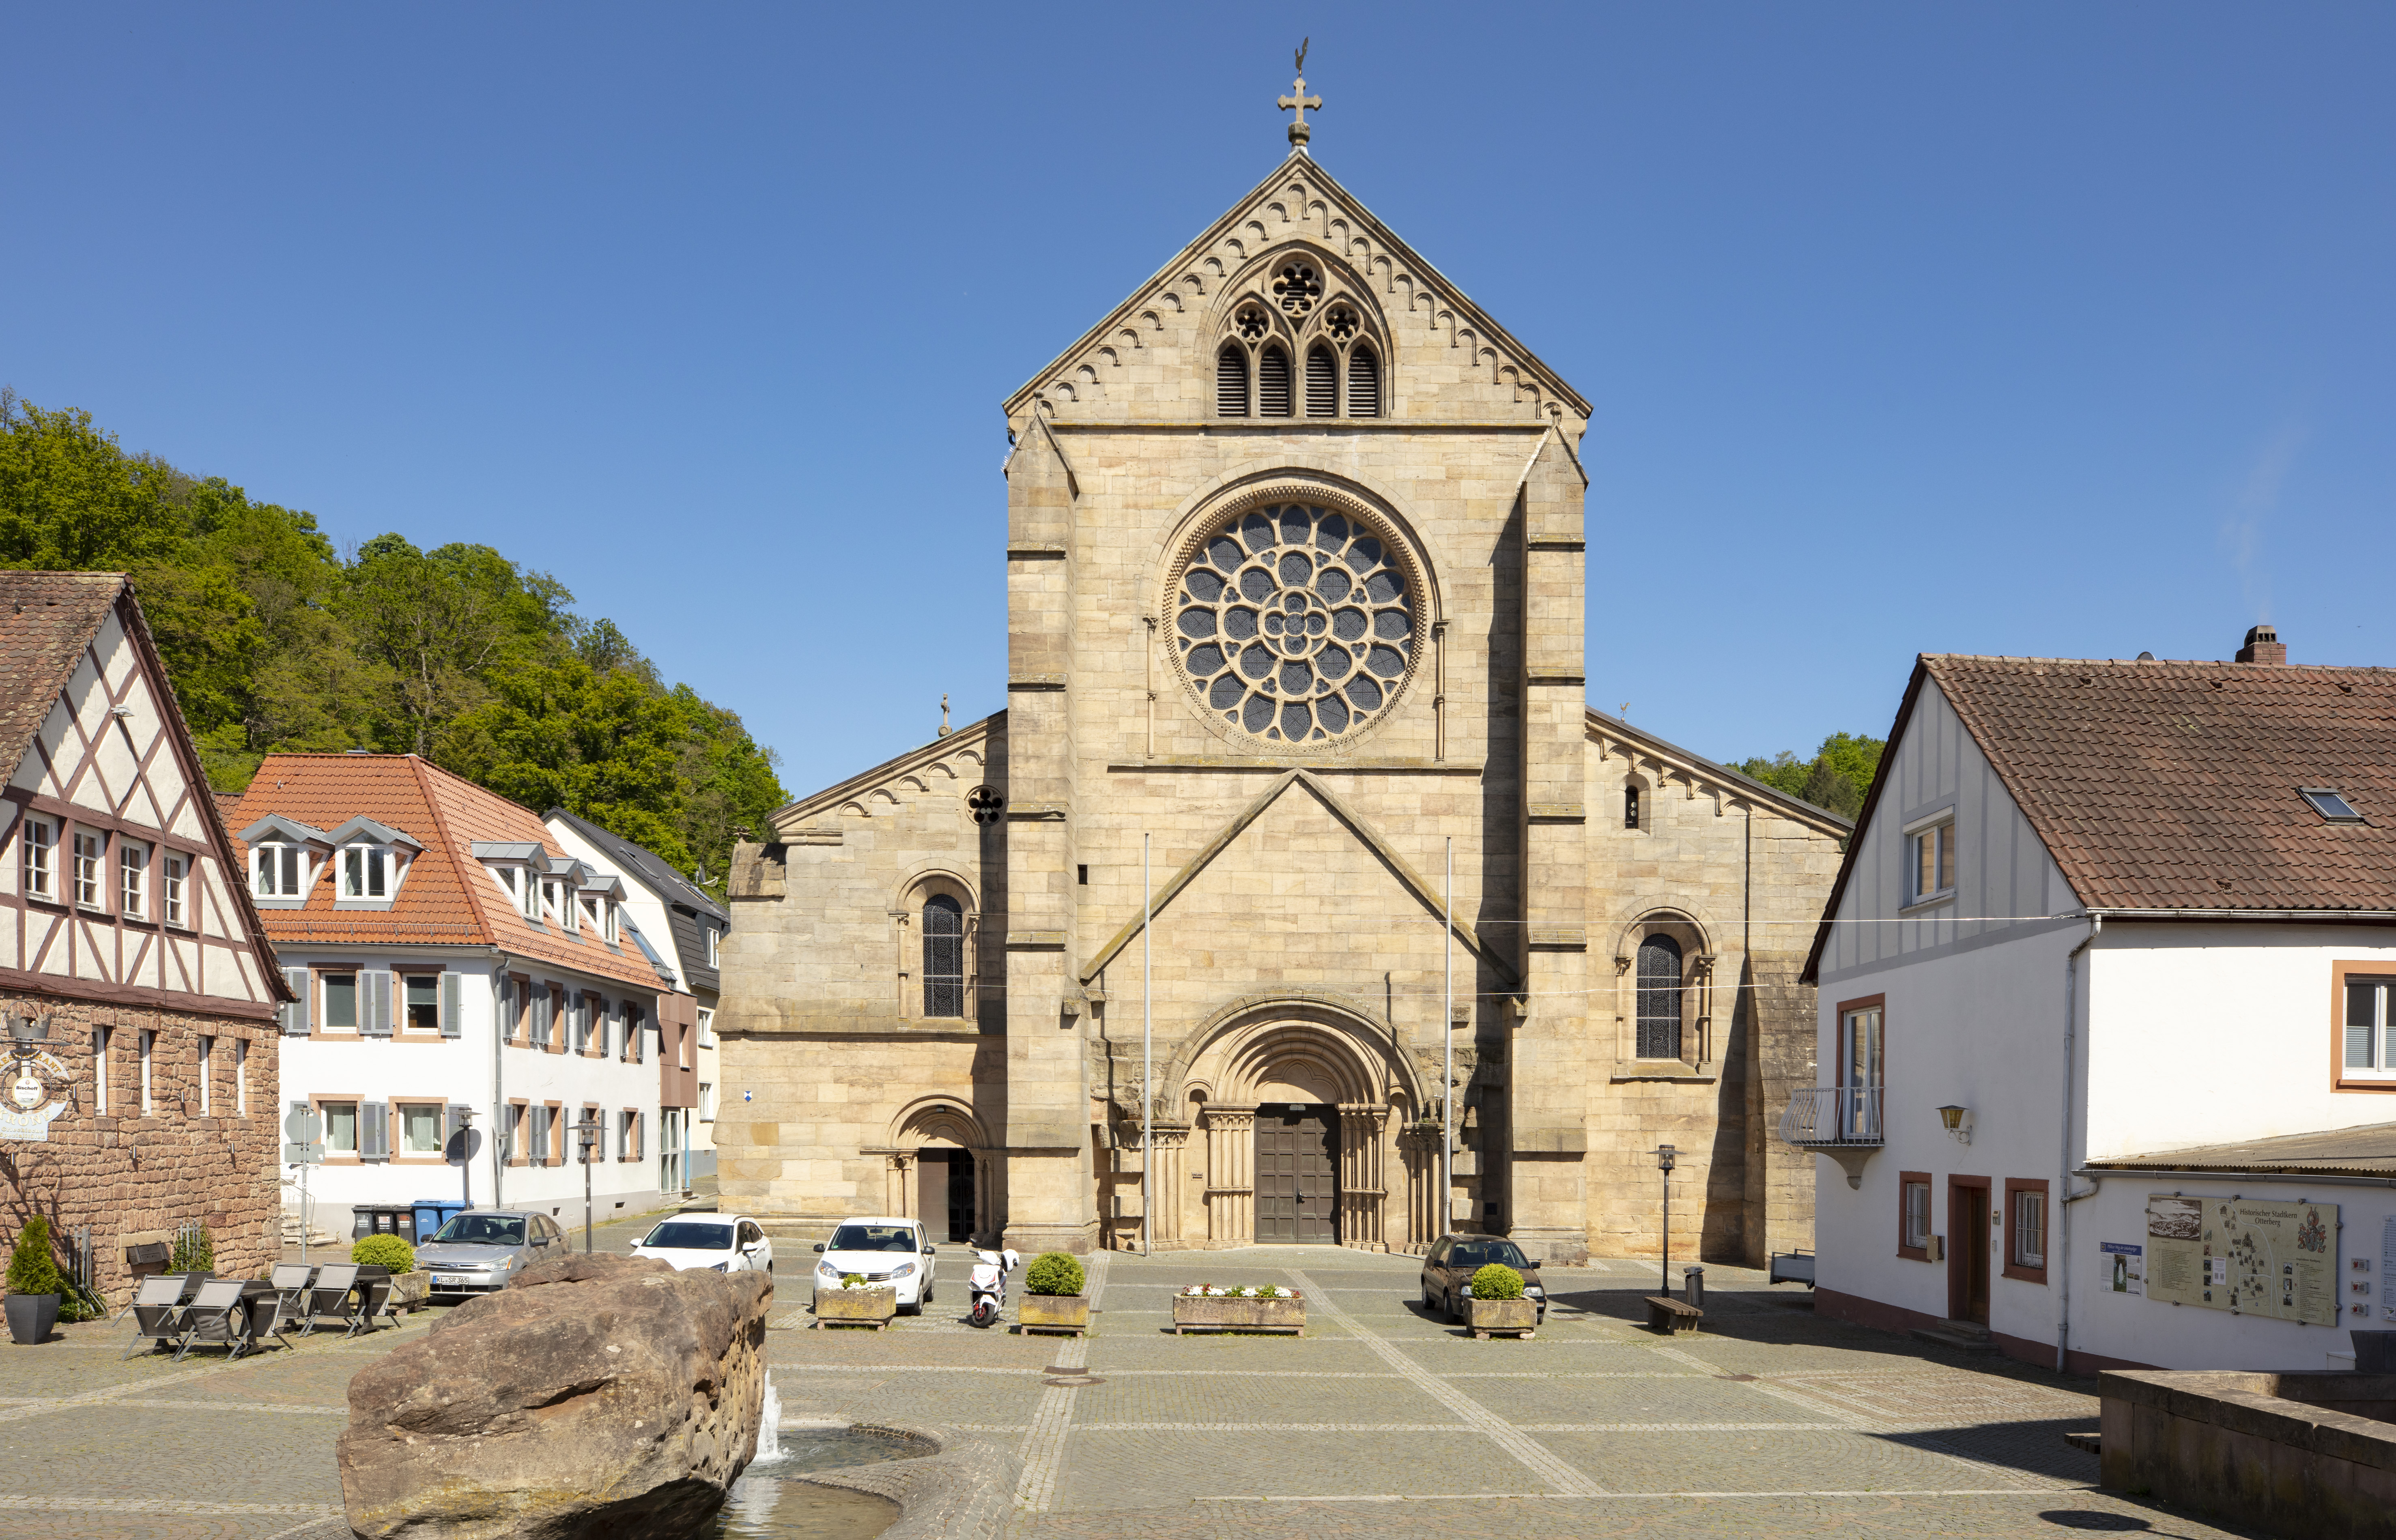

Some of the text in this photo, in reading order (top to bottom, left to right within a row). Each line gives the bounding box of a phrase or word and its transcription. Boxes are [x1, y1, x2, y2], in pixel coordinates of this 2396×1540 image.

[2240, 1208, 2297, 1218] Historischer Stadtkern
[2255, 1217, 2280, 1227] Otterberg
